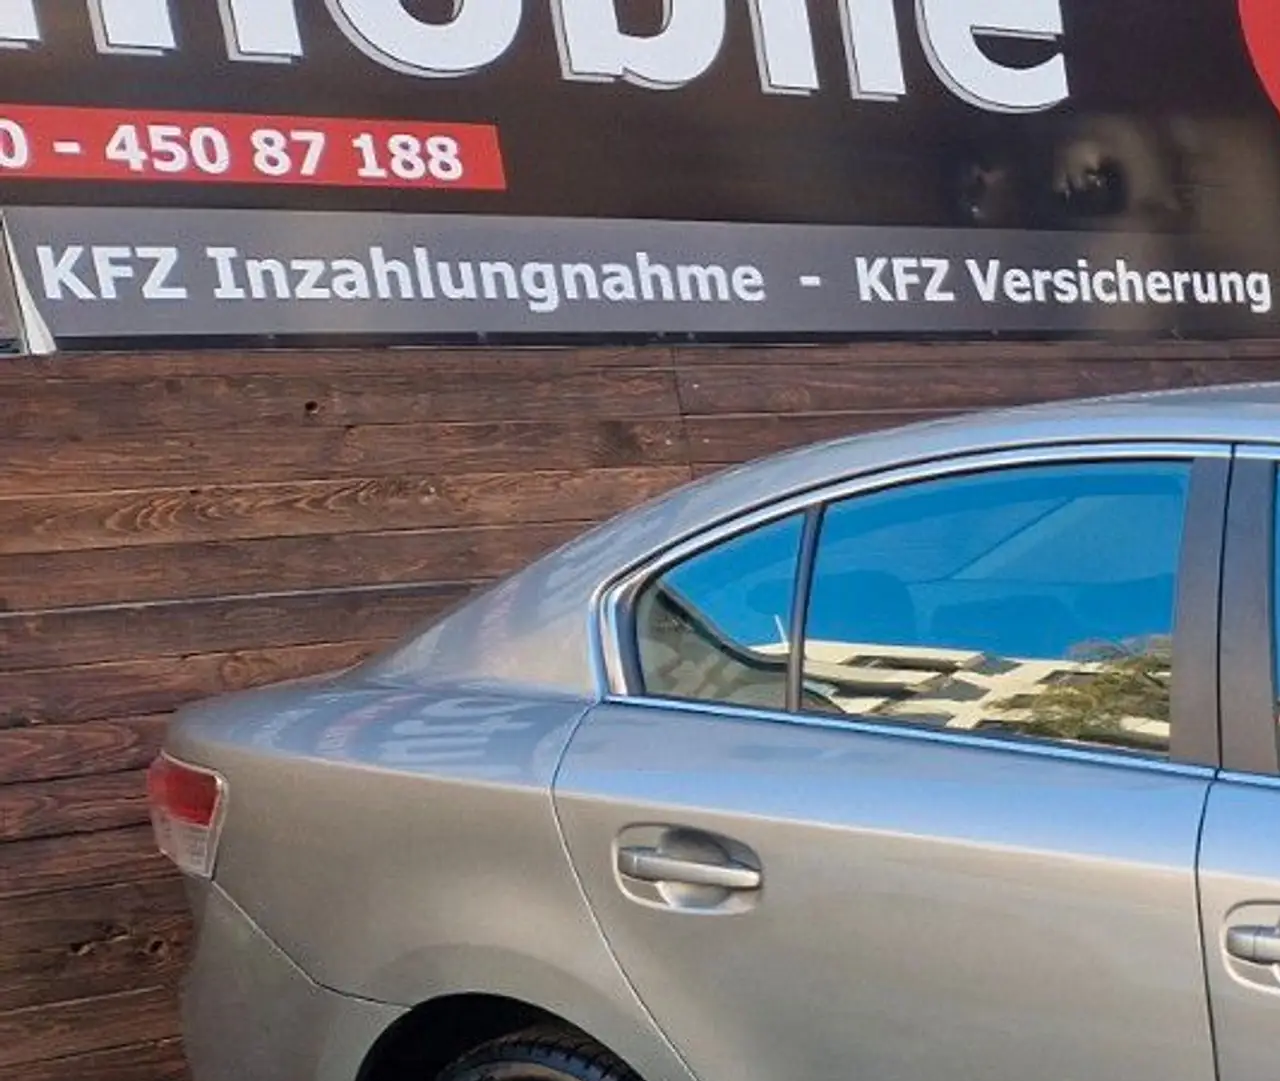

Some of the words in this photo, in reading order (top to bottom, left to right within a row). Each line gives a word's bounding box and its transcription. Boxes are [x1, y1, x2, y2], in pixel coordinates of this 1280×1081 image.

[52, 140, 82, 155] -
[105, 123, 231, 176] 450
[250, 128, 326, 177] 87
[351, 132, 465, 182] 188
[36, 245, 188, 300] KFZ
[206, 246, 767, 313] Inzahlungnahme
[800, 274, 822, 288] -
[855, 256, 955, 302] KFZ
[965, 258, 1272, 313] Versicherung
